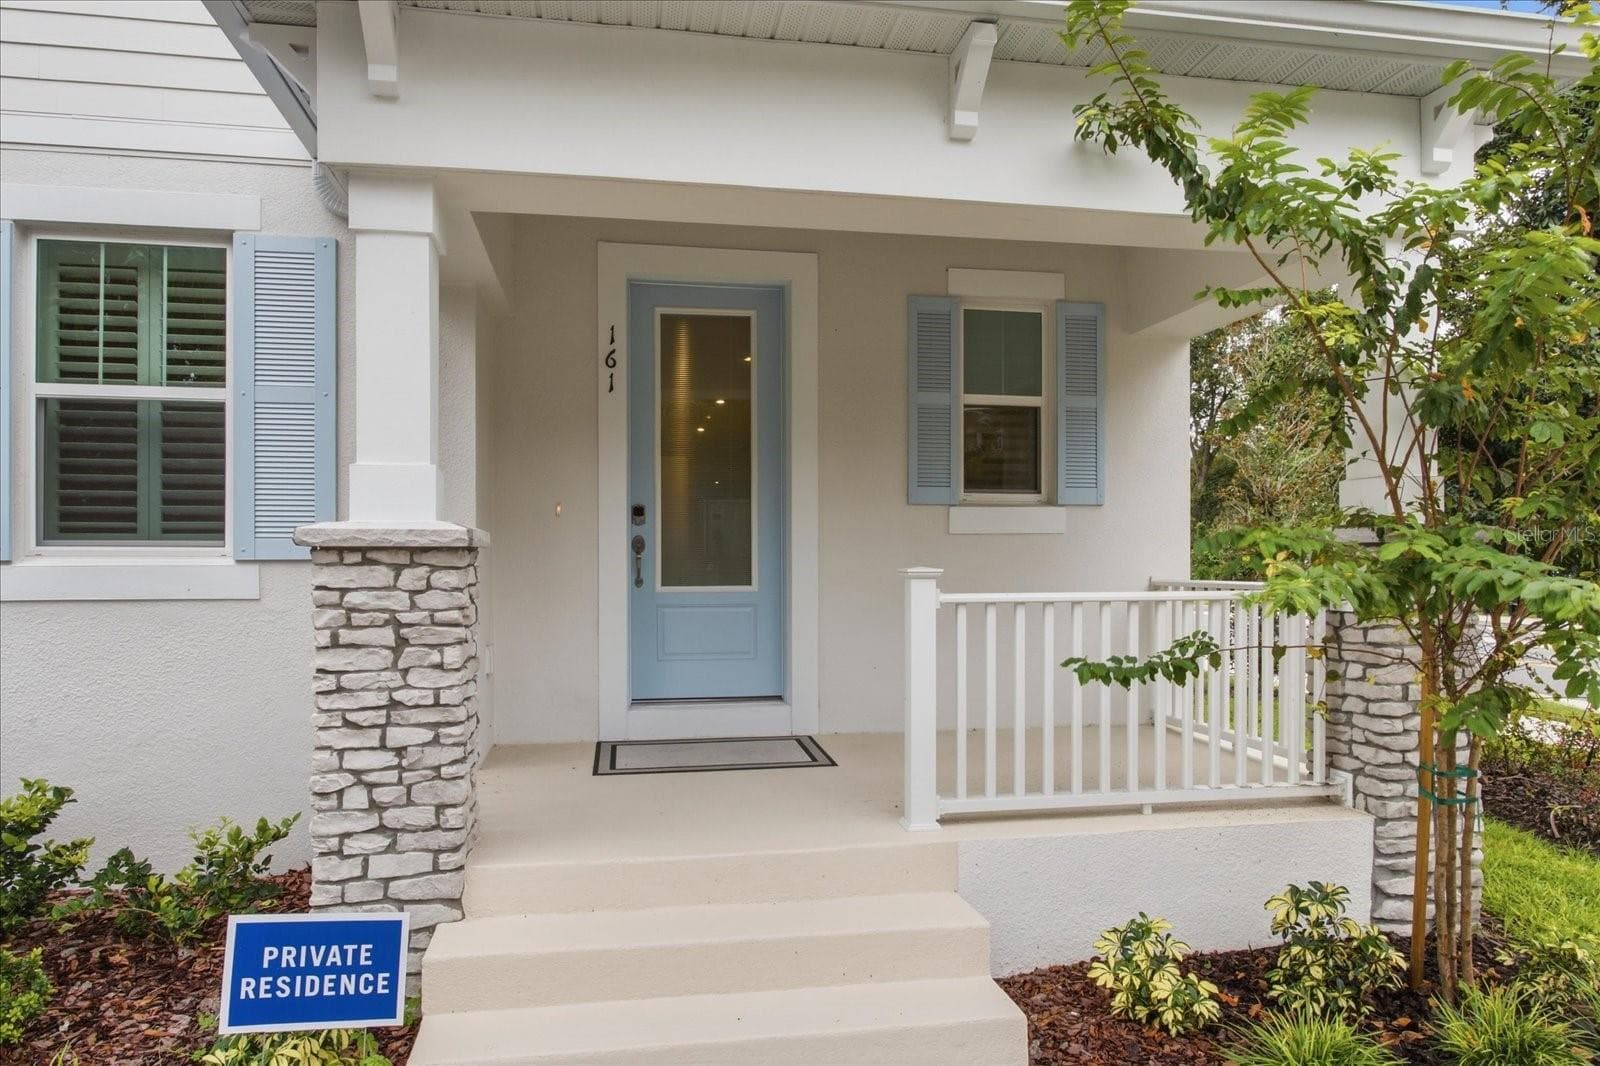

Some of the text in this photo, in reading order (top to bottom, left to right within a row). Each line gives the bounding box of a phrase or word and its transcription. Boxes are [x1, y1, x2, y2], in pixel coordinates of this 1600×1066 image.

[605, 325, 617, 393] 161
[262, 943, 374, 969] PRIVATE
[239, 972, 391, 1000] RESIDENCE
